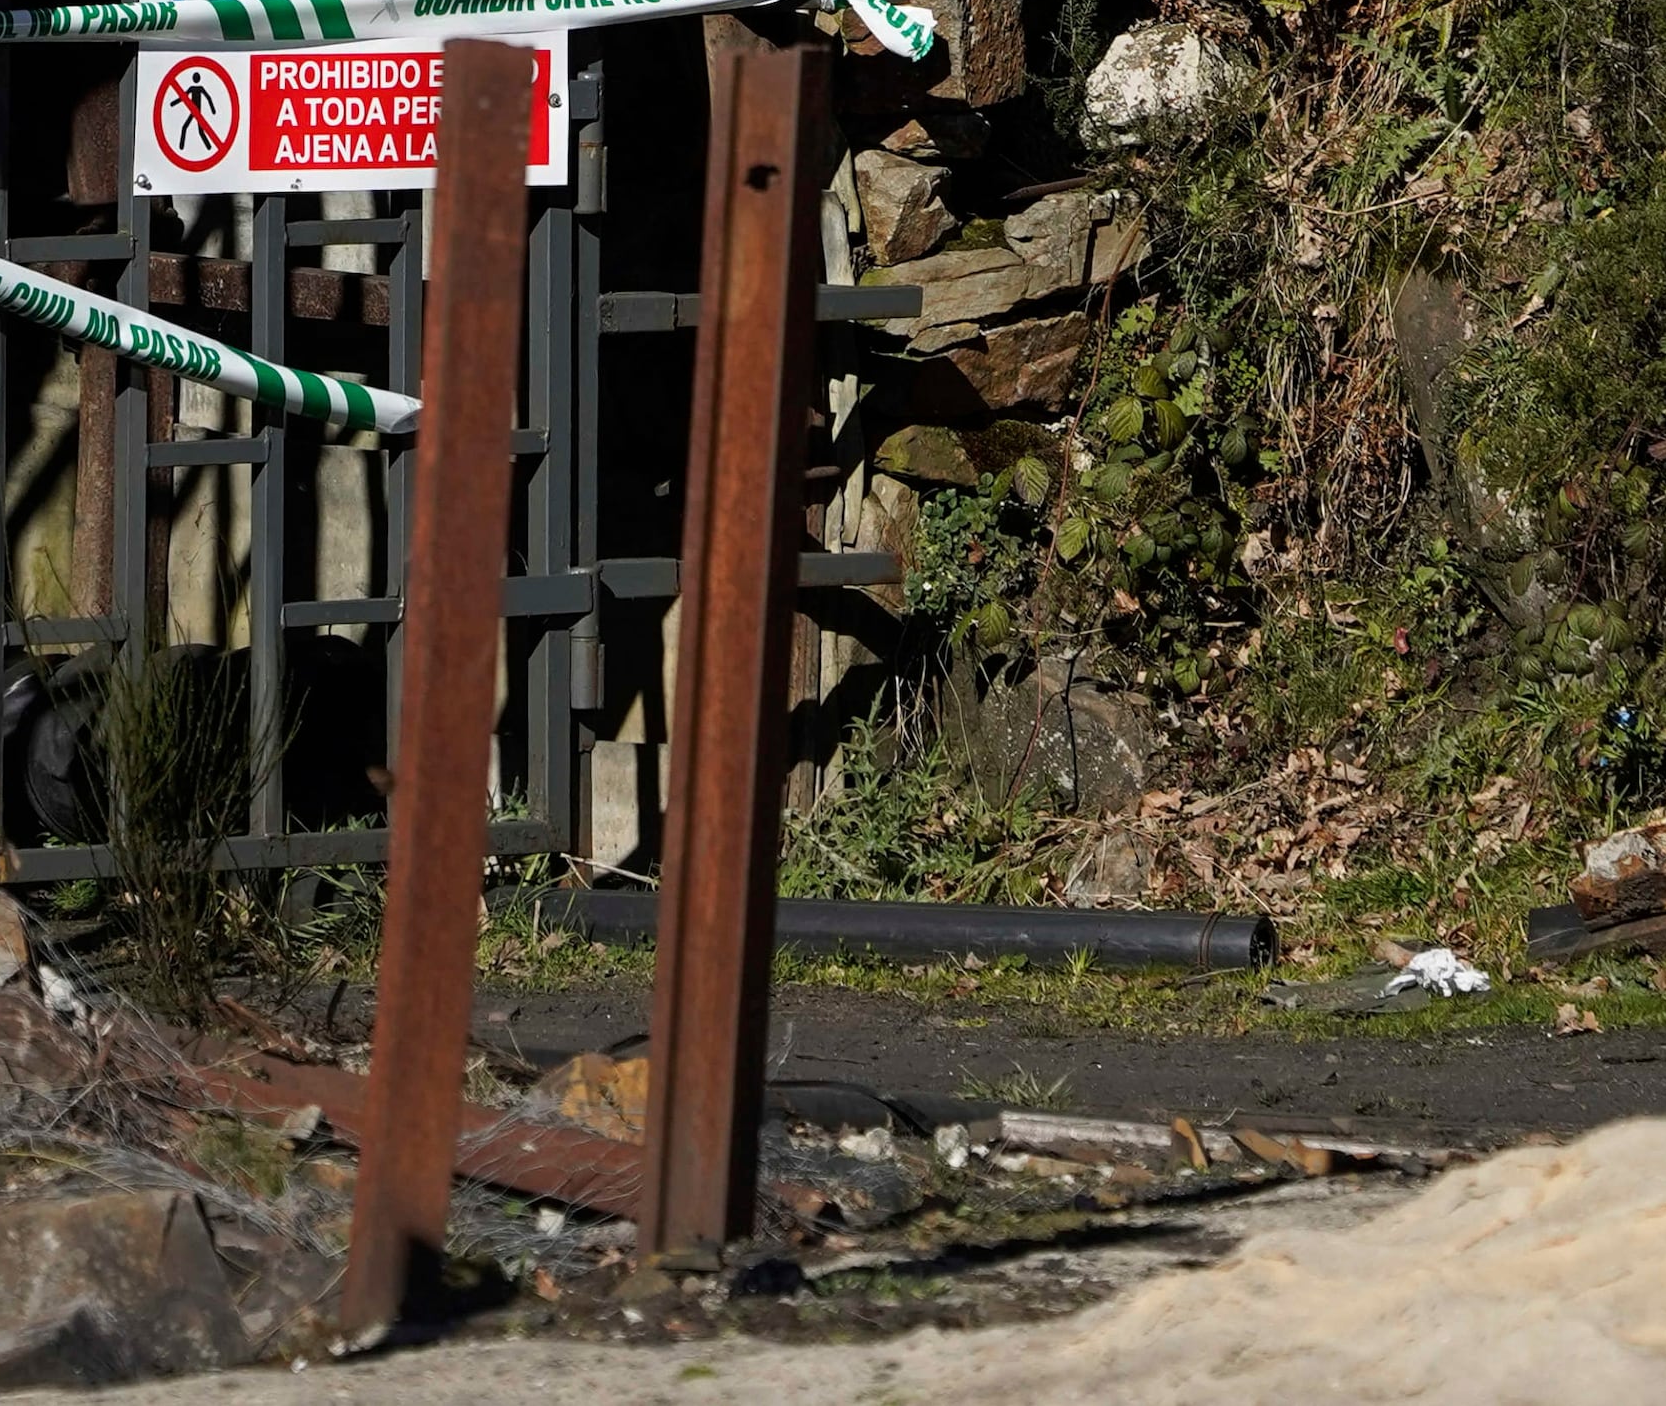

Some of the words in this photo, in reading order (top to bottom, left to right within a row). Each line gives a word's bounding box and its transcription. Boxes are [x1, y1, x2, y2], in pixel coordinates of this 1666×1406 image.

[79, 0, 178, 35] PASAR
[260, 59, 421, 91] PROHIBIDO
[276, 97, 298, 127] A
[304, 96, 387, 127] TODA
[274, 134, 374, 164] AJENA
[378, 133, 400, 162] A
[405, 132, 438, 161] LA
[80, 305, 123, 350] NO
[129, 323, 222, 382] PASAR
